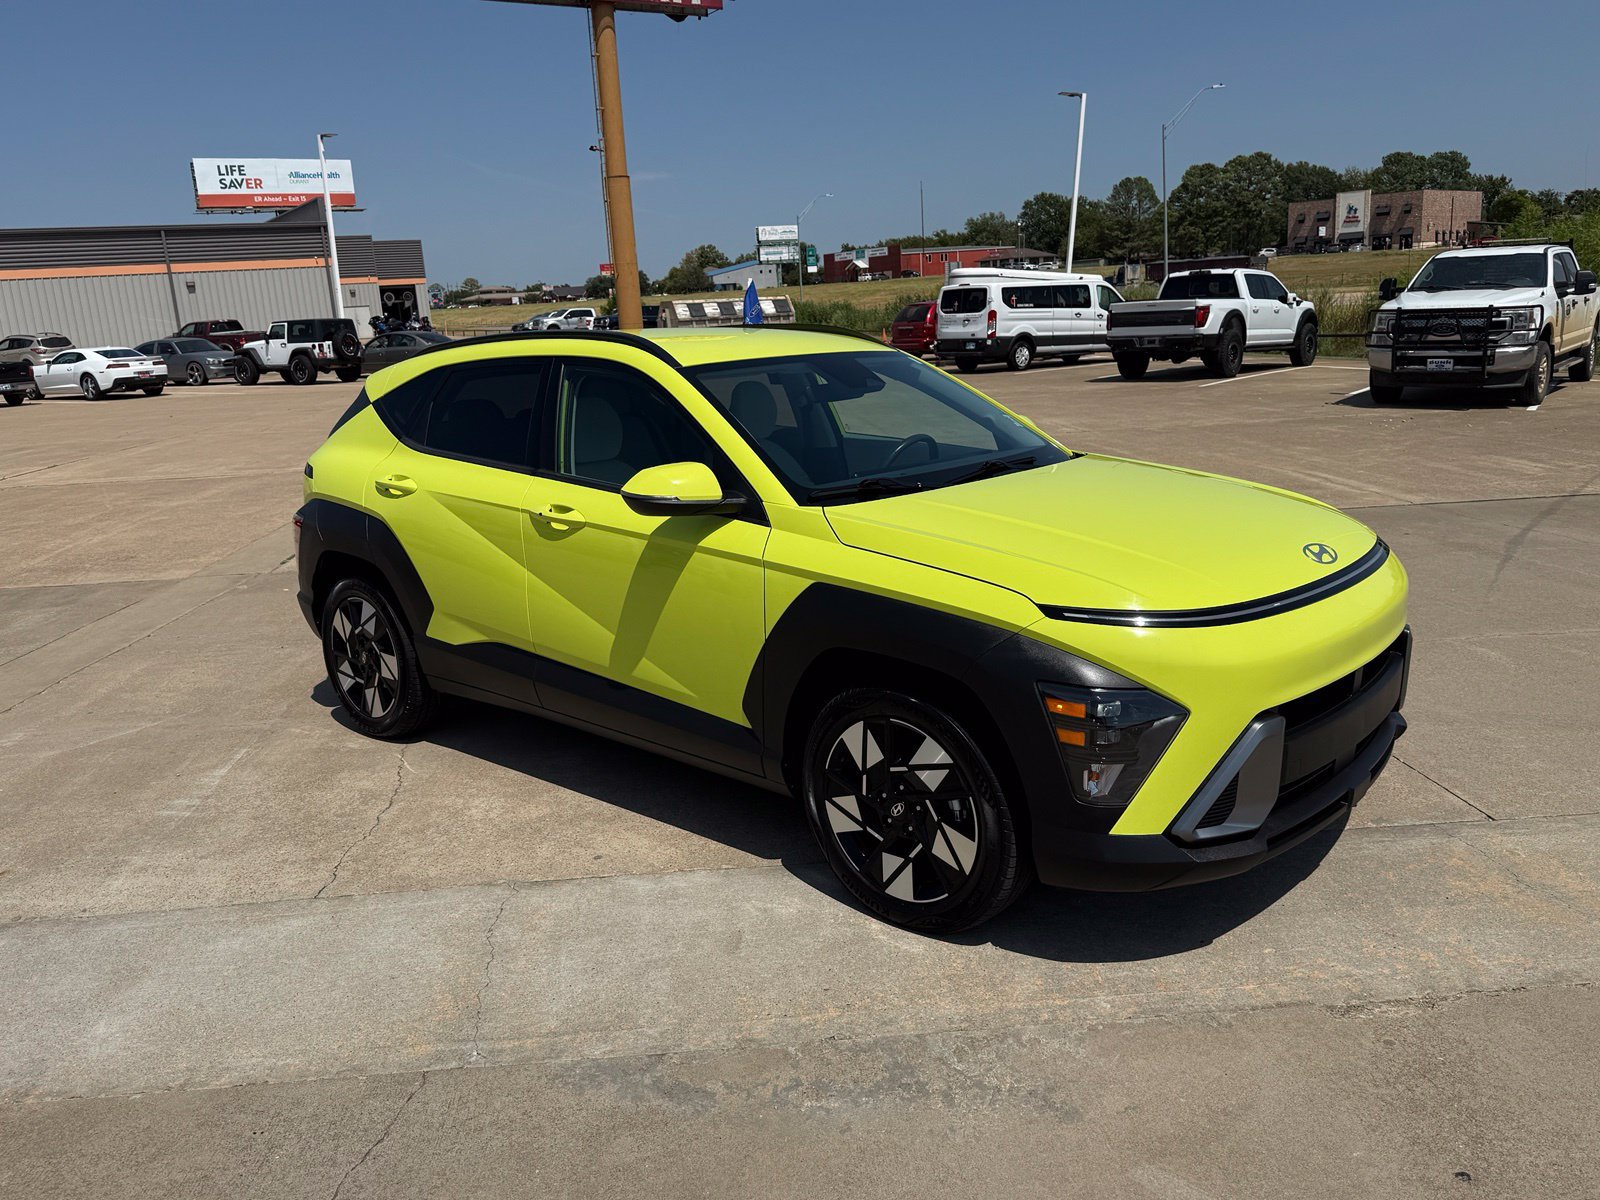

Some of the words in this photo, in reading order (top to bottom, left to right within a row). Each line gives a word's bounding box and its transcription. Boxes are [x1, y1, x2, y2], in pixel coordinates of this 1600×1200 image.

[217, 165, 246, 176] LIFE
[289, 171, 341, 179] AllianceHalth
[219, 178, 263, 189] SAVER
